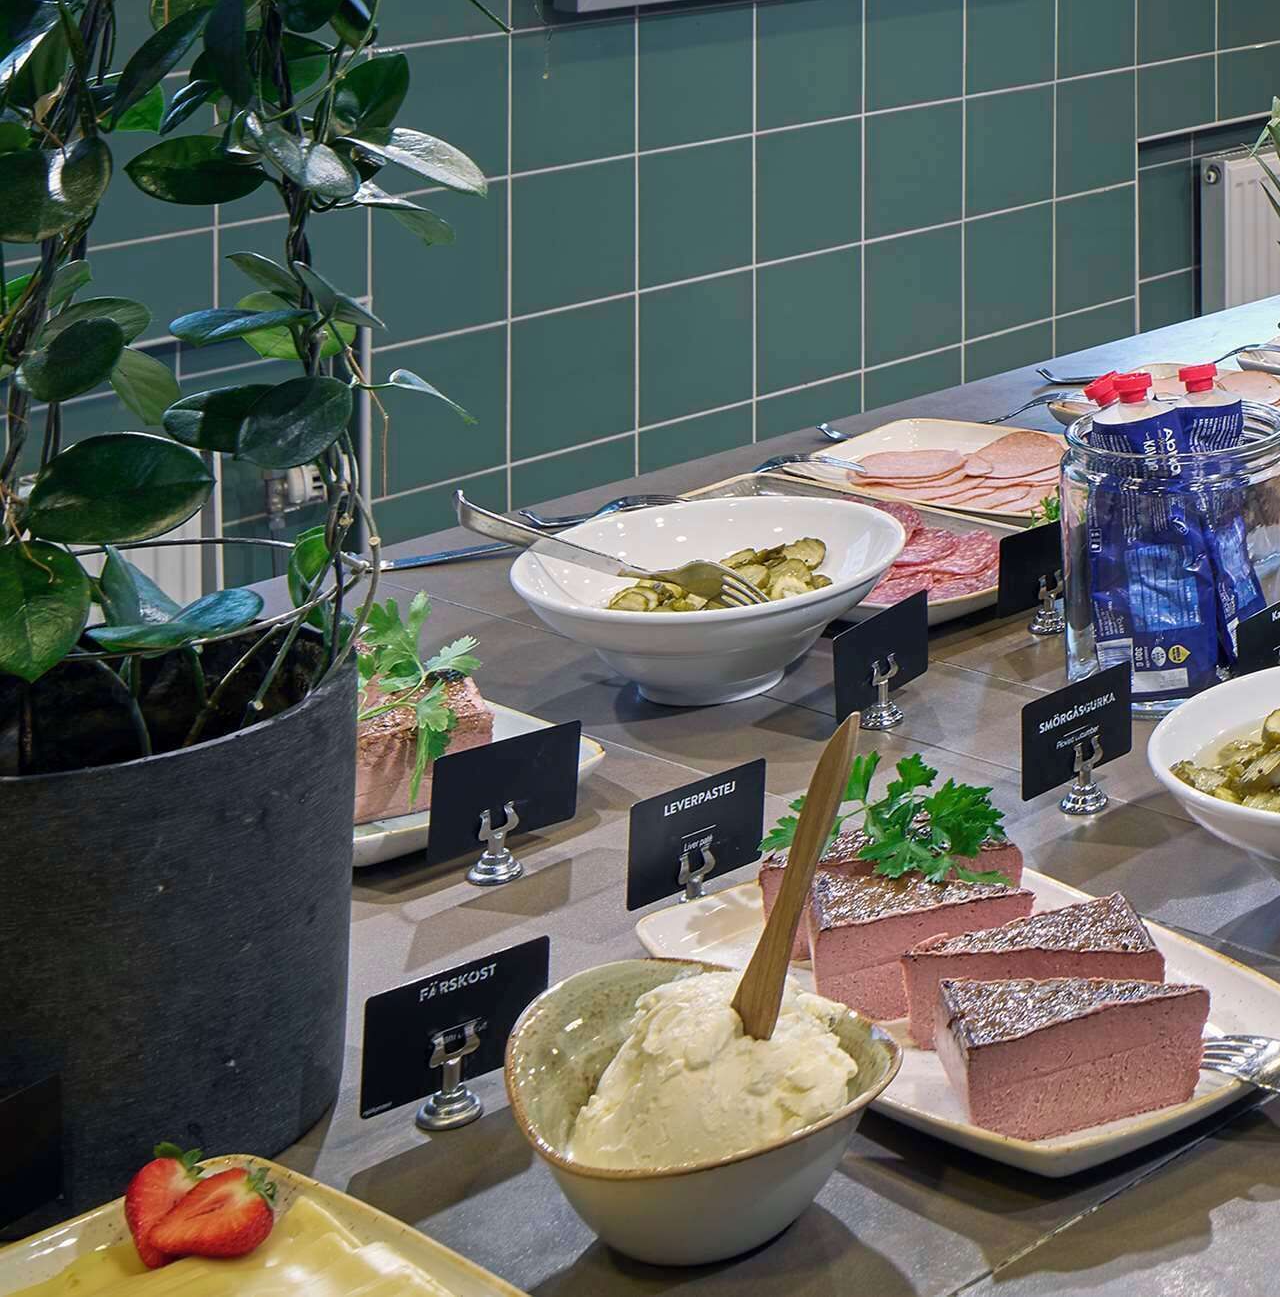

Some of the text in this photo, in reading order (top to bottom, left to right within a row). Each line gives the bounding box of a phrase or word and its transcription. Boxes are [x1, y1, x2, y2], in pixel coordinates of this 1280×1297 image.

[1039, 692, 1116, 734] SMÖRGÅSGURKA
[664, 781, 736, 817] LEVERPASTEJ
[418, 964, 496, 1002] FÄRSKOST
